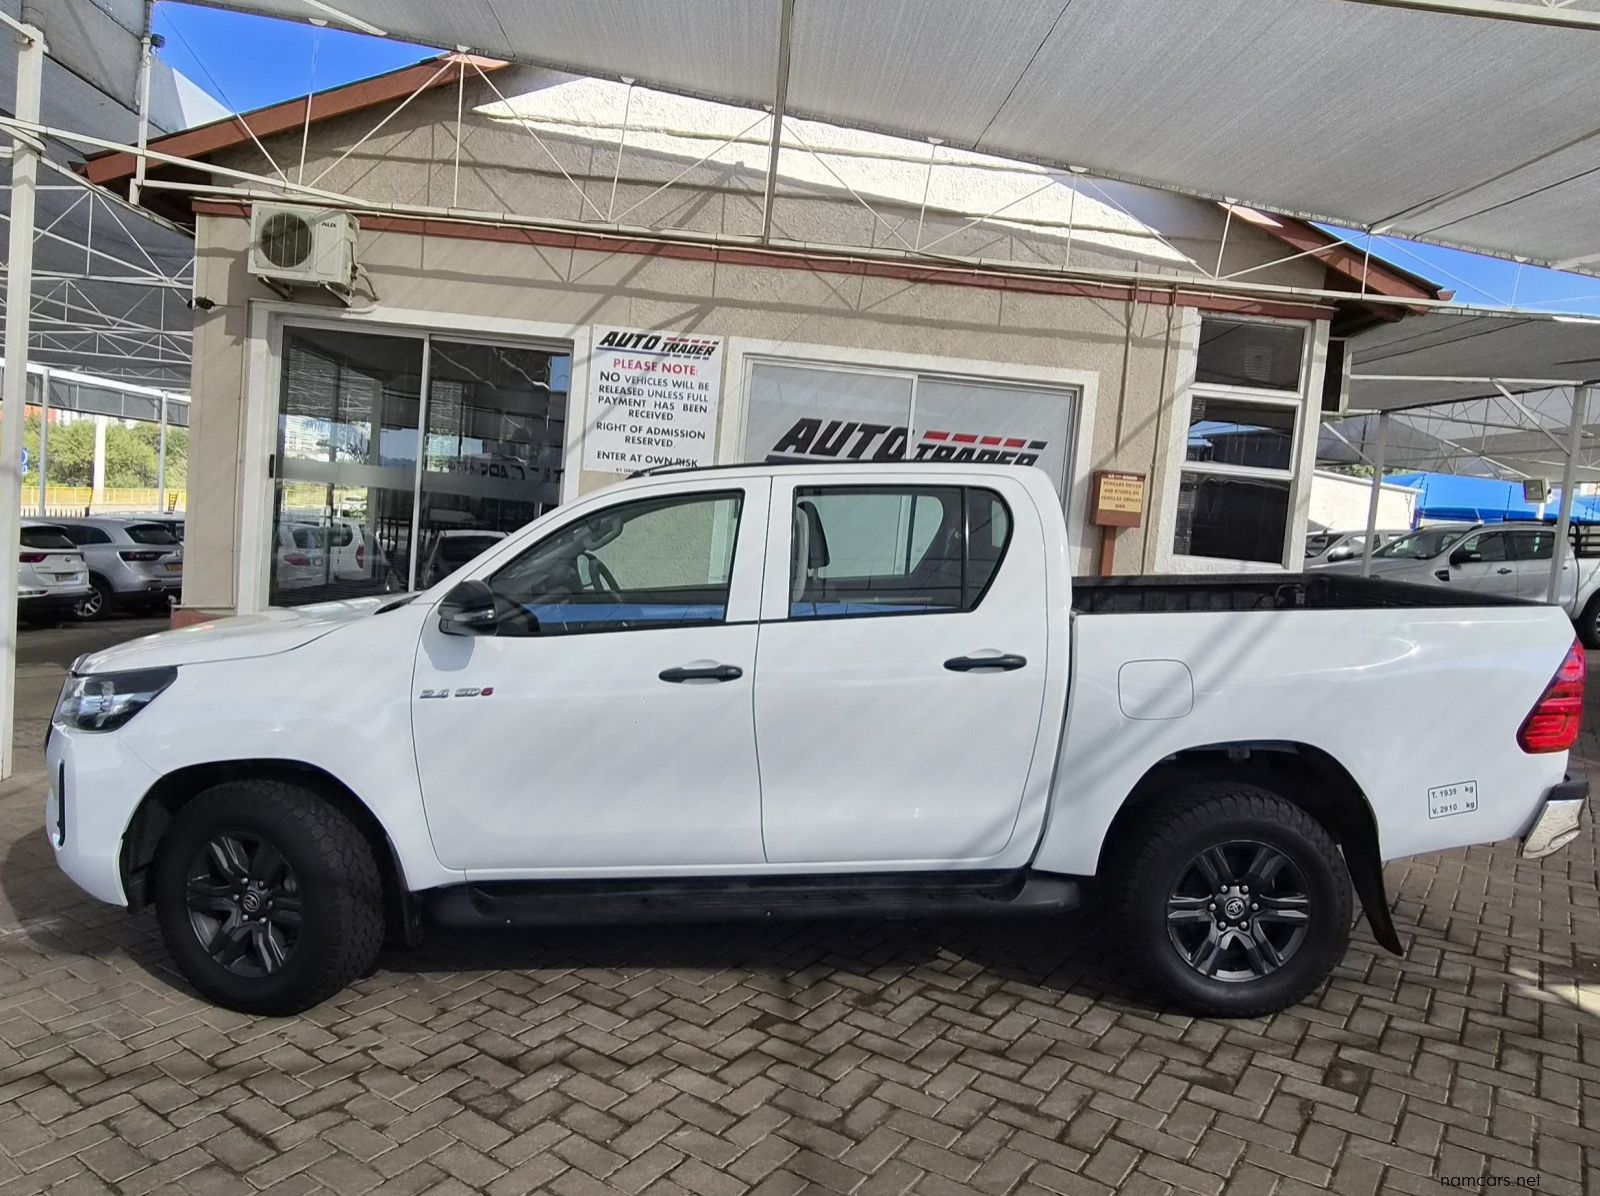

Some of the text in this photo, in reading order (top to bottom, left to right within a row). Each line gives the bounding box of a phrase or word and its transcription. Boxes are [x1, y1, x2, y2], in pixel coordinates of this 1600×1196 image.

[598, 331, 716, 356] AUTO TRADER
[613, 358, 658, 372] PLEASE
[600, 371, 710, 391] NO VEHICLES WILL BE
[598, 385, 708, 402] RELEASED UNLESS FULL
[598, 396, 708, 413] PAYMENT HAS BEEN
[596, 422, 706, 439] RIGHT OF ADMISSION
[772, 417, 915, 462] AUTO
[597, 450, 627, 461] ENTER
[629, 454, 642, 463] AT
[645, 455, 672, 466] OWN
[1440, 787, 1457, 797] 1939
[1464, 785, 1474, 794] kg
[1465, 801, 1475, 809] kg
